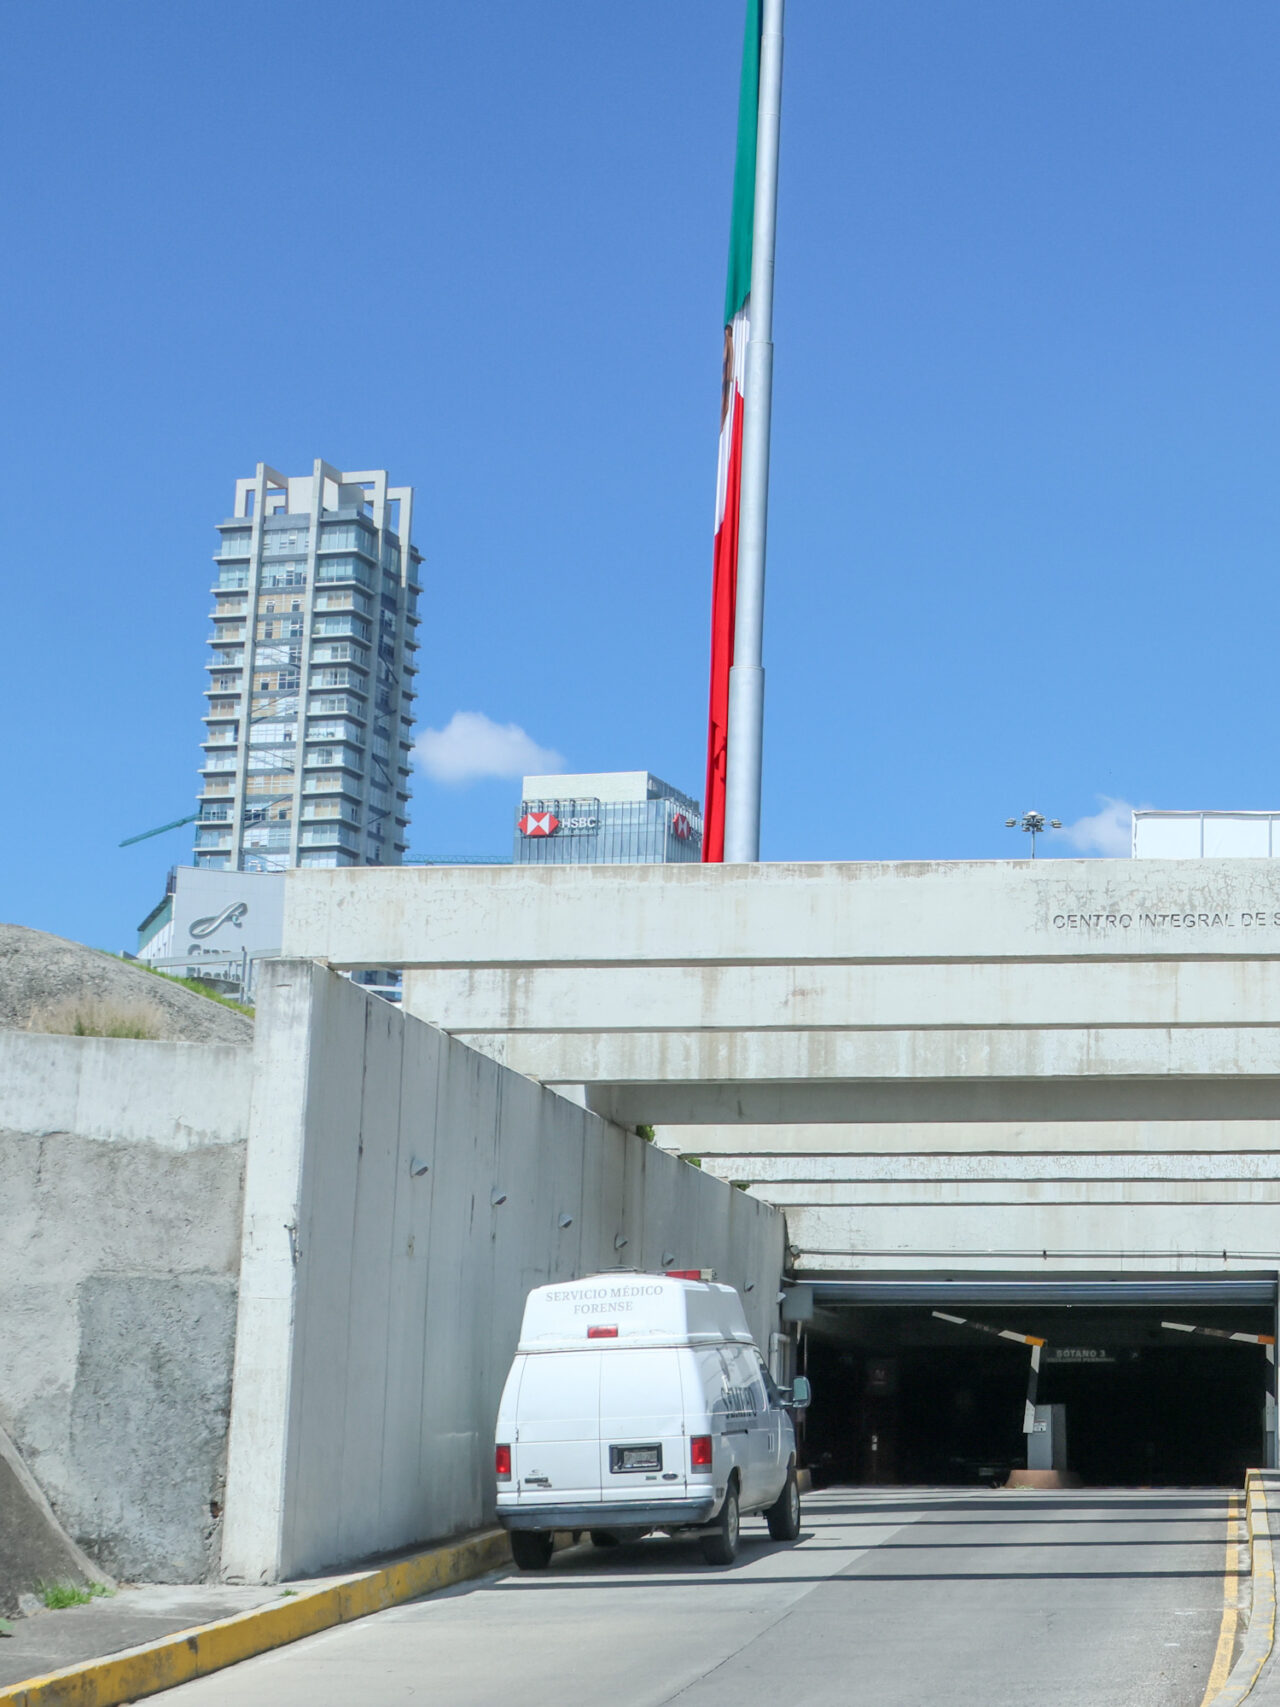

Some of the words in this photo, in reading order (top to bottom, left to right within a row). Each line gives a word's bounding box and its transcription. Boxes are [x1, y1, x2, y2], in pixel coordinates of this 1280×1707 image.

[562, 816, 596, 828] HSBC
[1053, 914, 1133, 928] CENTRO
[1139, 912, 1236, 928] INTEGRAL
[1241, 912, 1266, 927] DE
[546, 1288, 608, 1302] SERVICIO
[610, 1285, 664, 1298] MÉDICO
[573, 1301, 633, 1314] FORENSE
